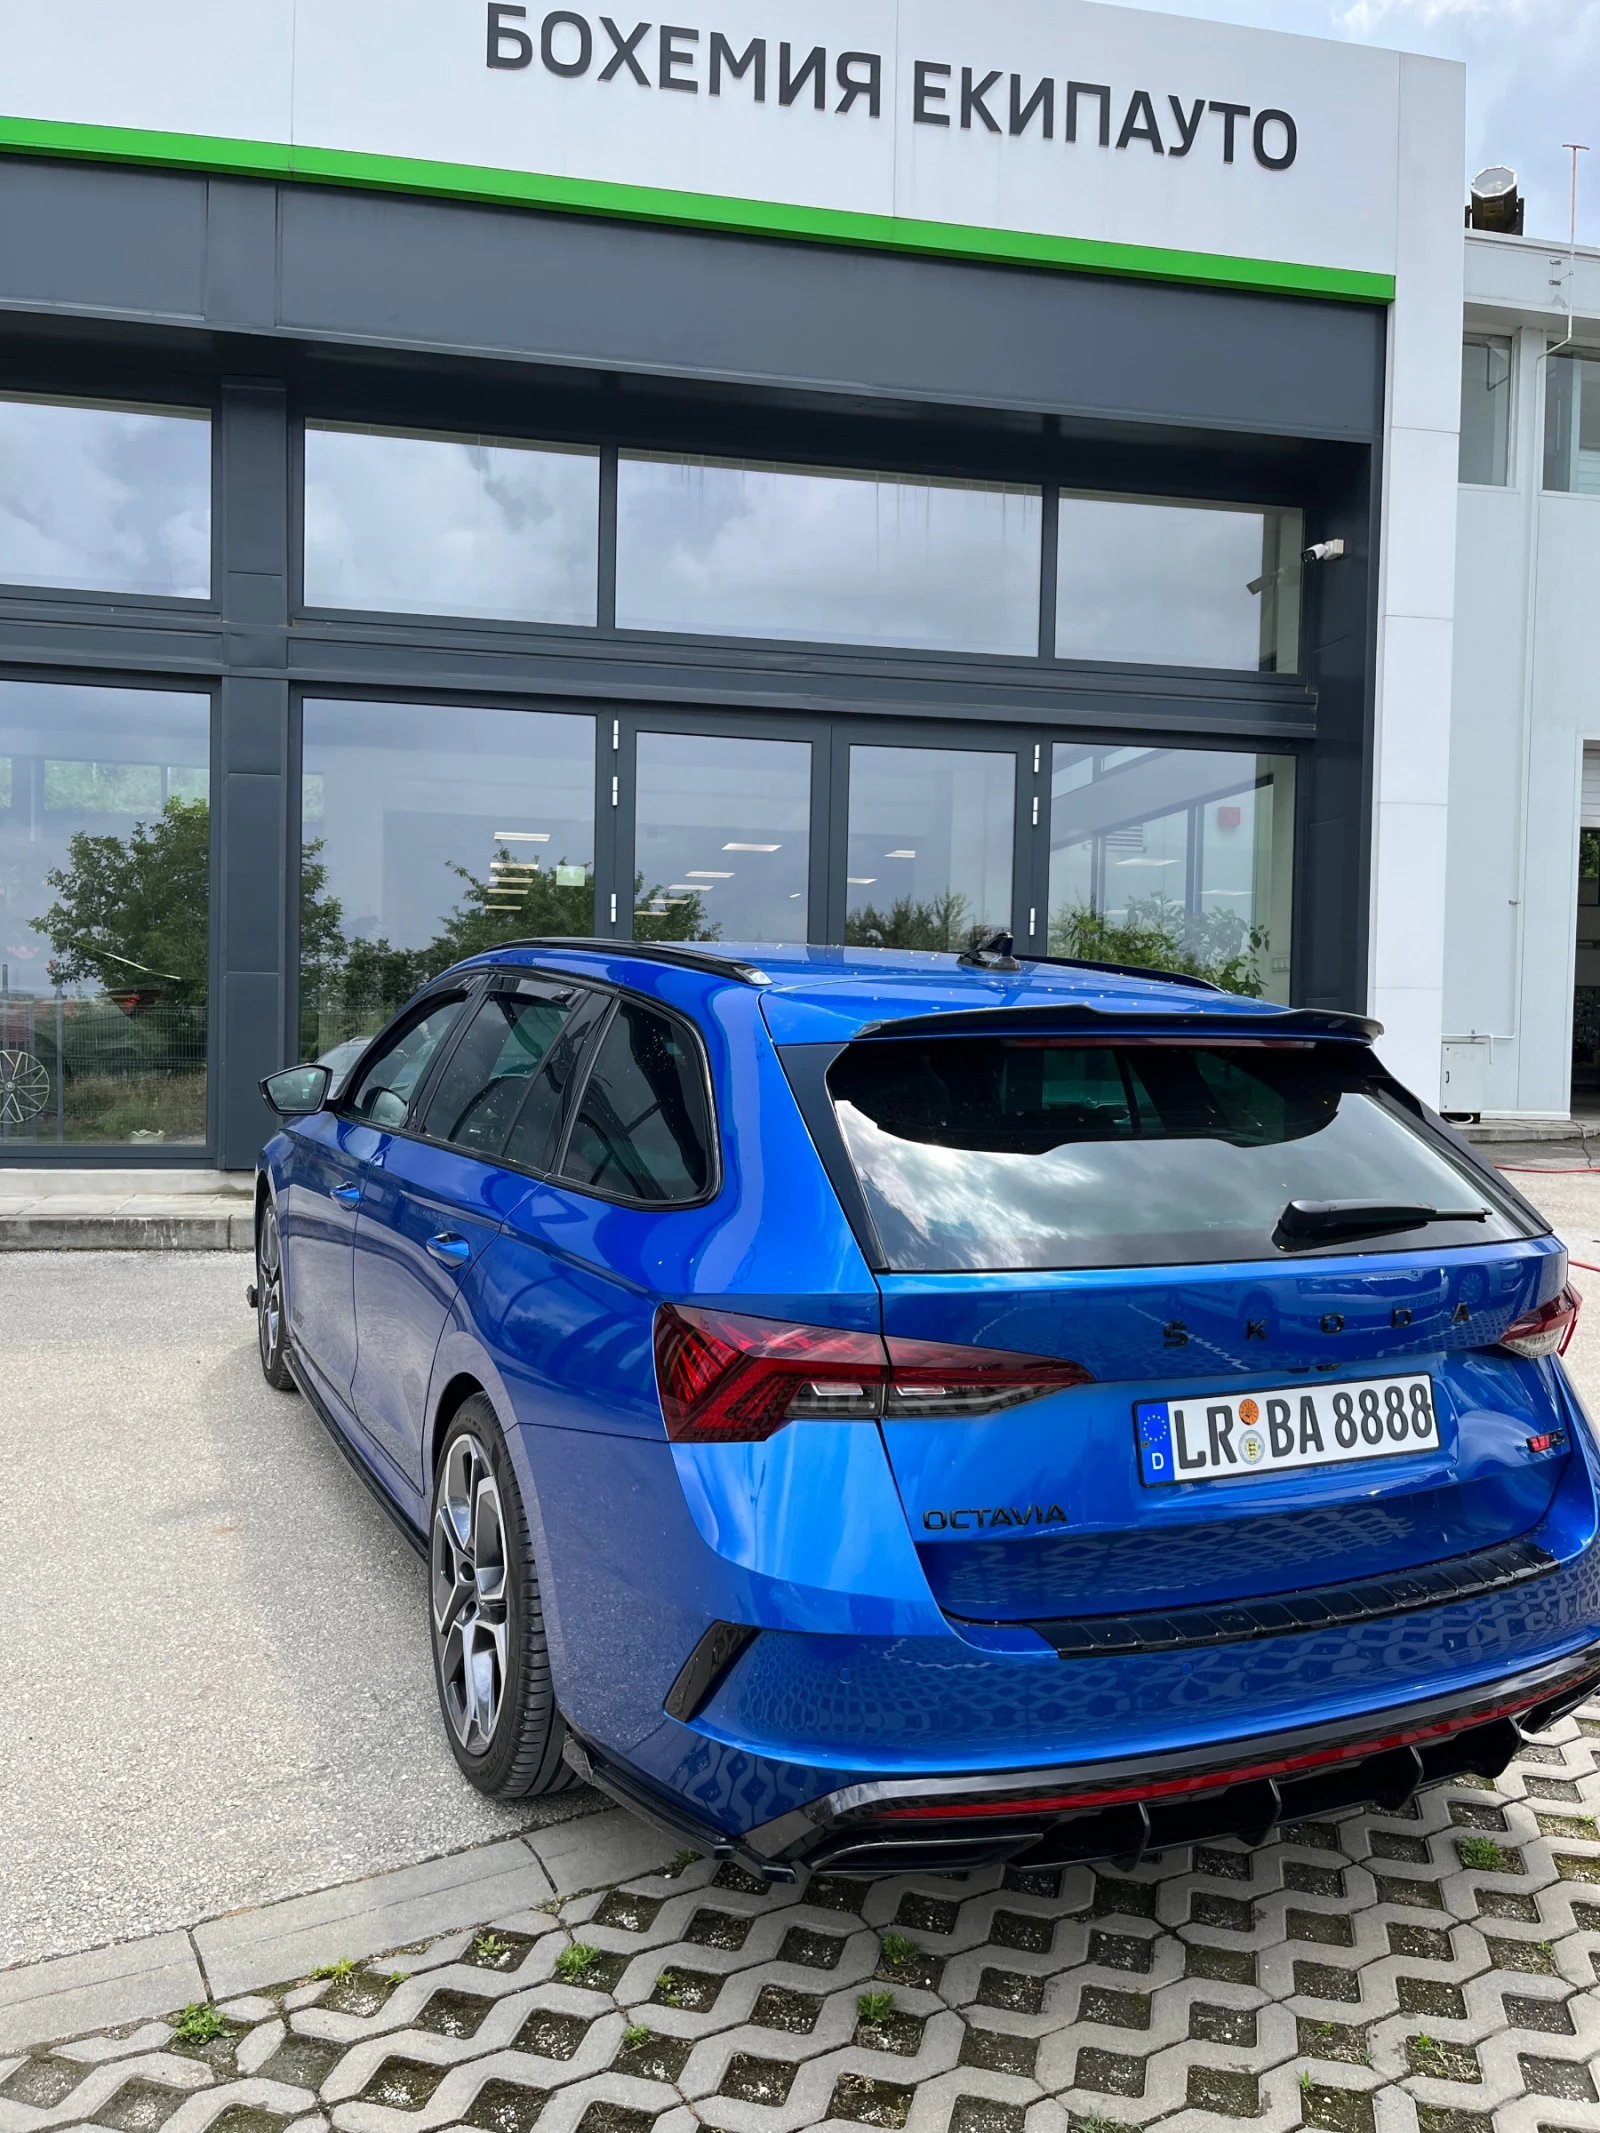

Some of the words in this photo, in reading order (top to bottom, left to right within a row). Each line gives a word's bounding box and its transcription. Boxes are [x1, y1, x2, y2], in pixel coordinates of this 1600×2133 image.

[486, 2, 882, 118] БОХЕМИЯ
[913, 61, 1299, 171] ЕКИПАУТО
[1163, 1301, 1471, 1347] ŠKODA
[1174, 1405, 1238, 1469] LR
[1267, 1395, 1324, 1457] BA
[1333, 1383, 1433, 1448] 8888
[1152, 1452, 1164, 1470] D
[923, 1504, 1068, 1530] OCTAVIA
